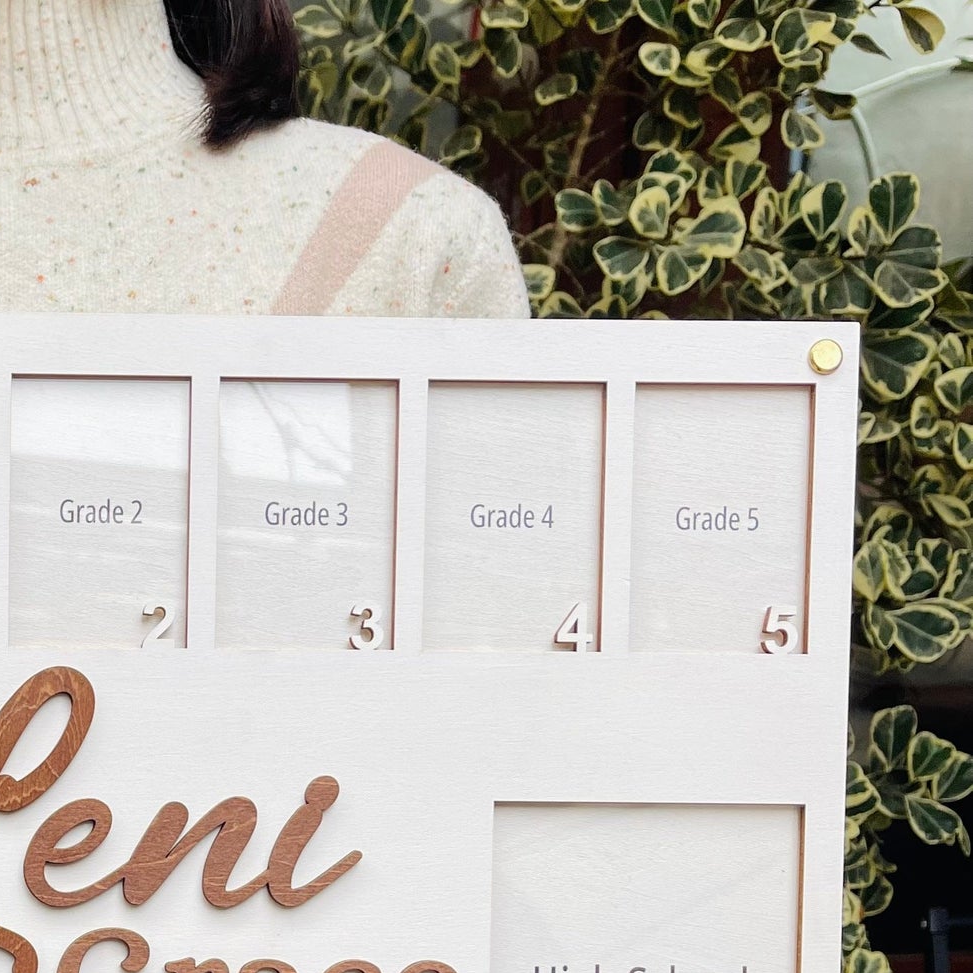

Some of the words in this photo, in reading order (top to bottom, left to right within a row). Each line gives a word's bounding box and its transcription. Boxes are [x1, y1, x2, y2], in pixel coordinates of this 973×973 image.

[59, 498, 124, 524] Grade
[130, 499, 143, 524] 2
[264, 500, 330, 526] Grade
[336, 502, 348, 527] 3
[470, 503, 535, 529] Grade
[541, 504, 554, 529] 4
[675, 505, 741, 531] Grade
[747, 507, 759, 532] 5
[142, 604, 175, 648] 2
[349, 604, 384, 651] 3
[554, 601, 593, 653] 4
[760, 604, 799, 654] 5
